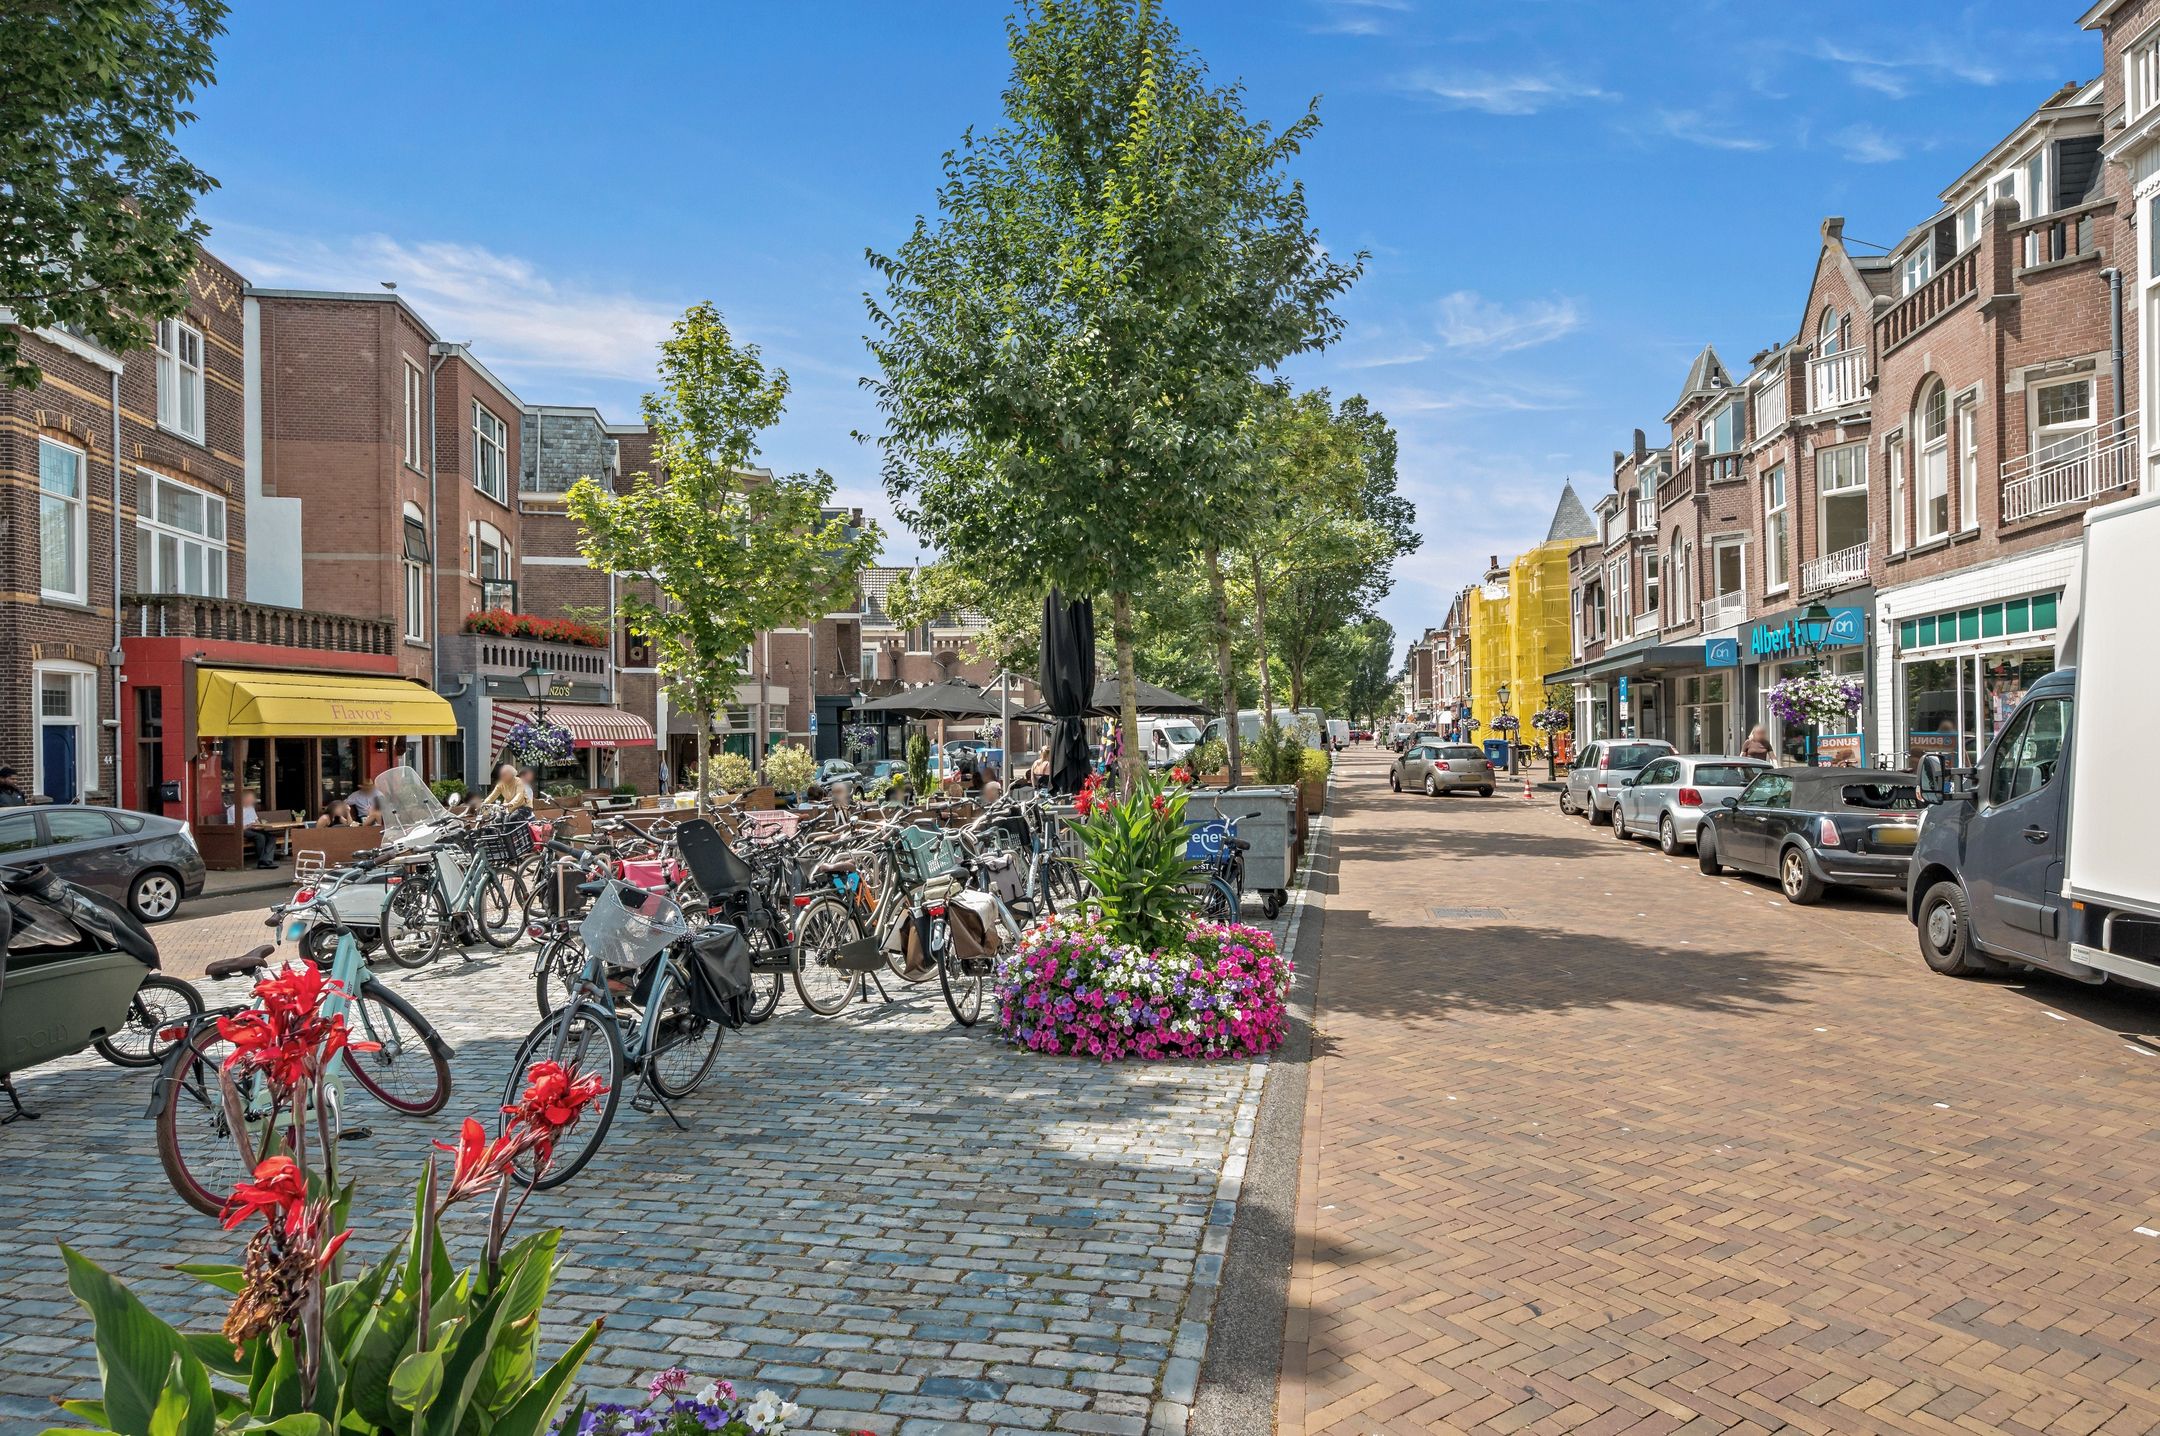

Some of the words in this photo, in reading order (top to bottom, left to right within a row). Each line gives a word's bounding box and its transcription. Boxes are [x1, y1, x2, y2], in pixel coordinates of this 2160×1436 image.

[1751, 620, 1791, 656] Albert
[548, 686, 570, 697] NZO'S
[331, 704, 392, 721] Flavor's
[1821, 738, 1859, 747] BONUS
[104, 755, 113, 765] 44
